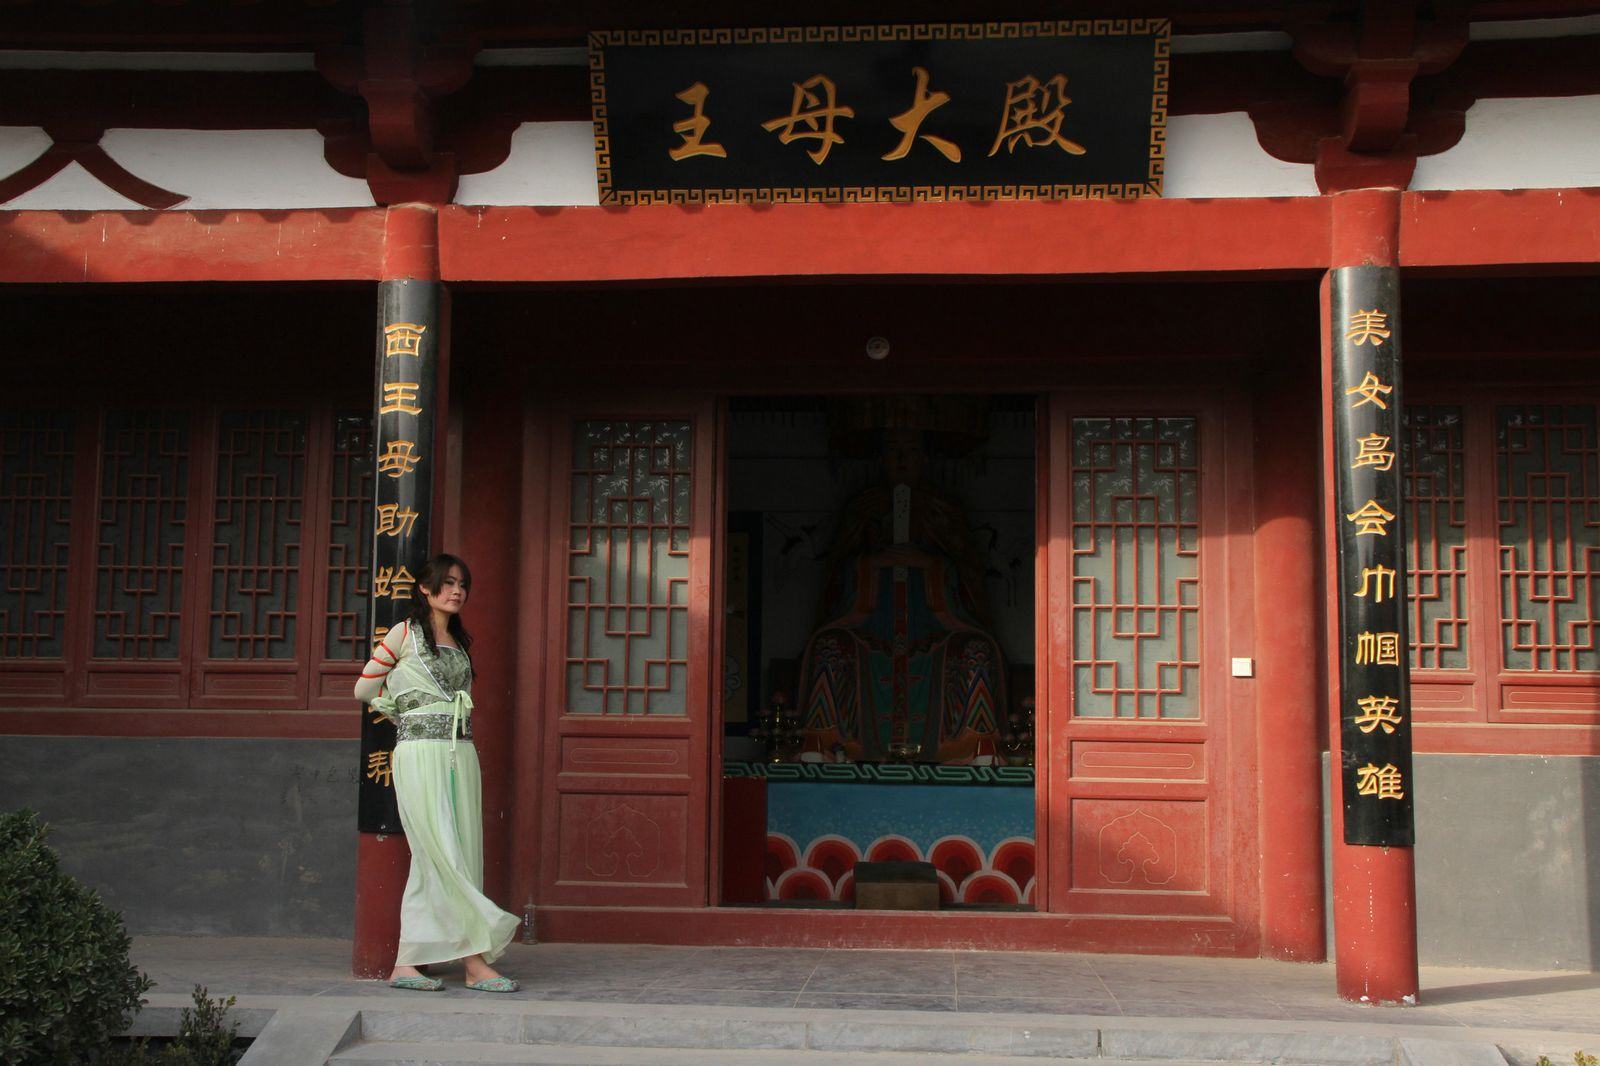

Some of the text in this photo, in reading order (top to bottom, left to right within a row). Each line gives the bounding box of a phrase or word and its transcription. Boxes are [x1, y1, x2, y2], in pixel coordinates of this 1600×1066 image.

[668, 66, 1087, 165] 王母大殿
[1345, 308, 1405, 801] 美女岛会巾帼英雄
